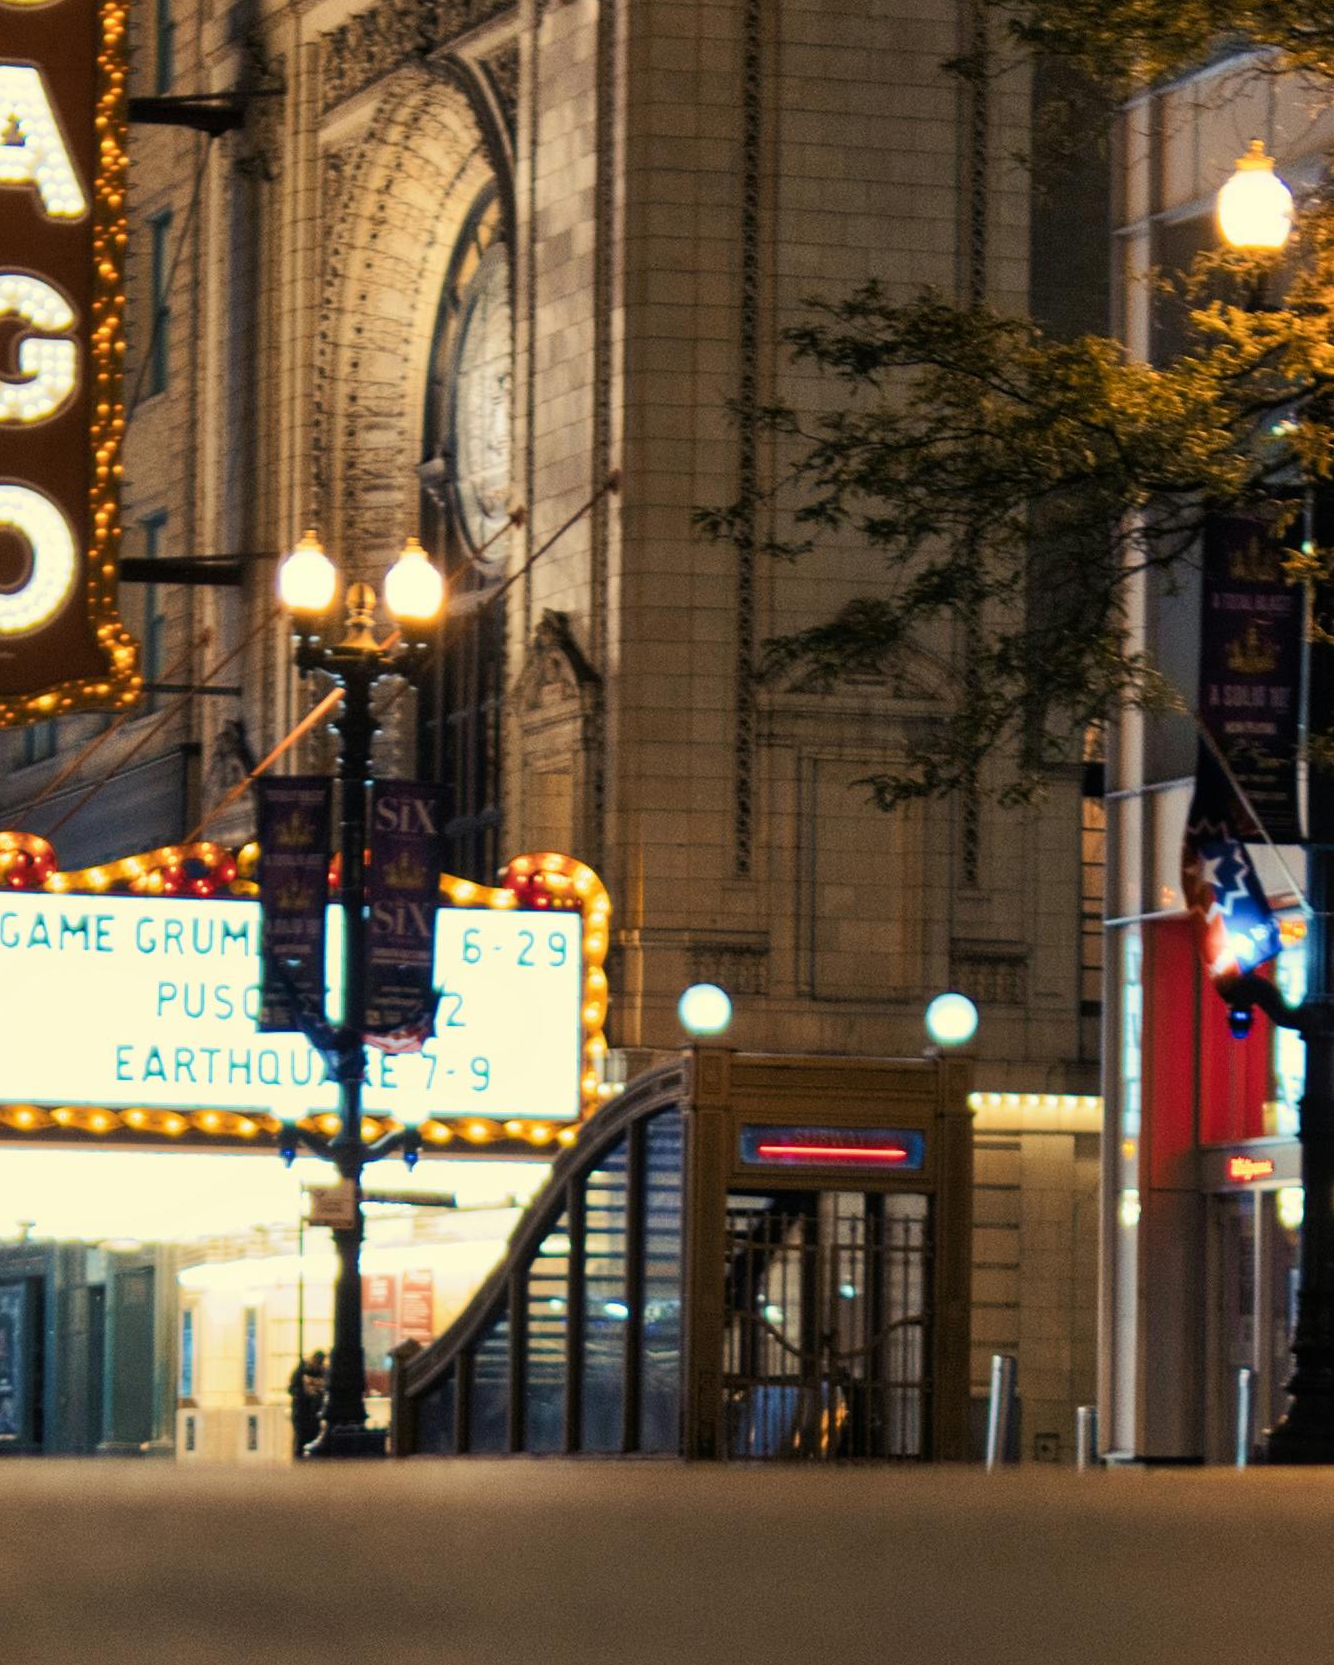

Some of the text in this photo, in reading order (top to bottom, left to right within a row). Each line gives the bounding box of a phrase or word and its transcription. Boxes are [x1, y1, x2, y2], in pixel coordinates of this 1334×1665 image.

[0, 911, 116, 952] GAME
[136, 916, 262, 957] GRUM
[462, 928, 567, 968] 6-29
[423, 1053, 490, 1092] 7-9
